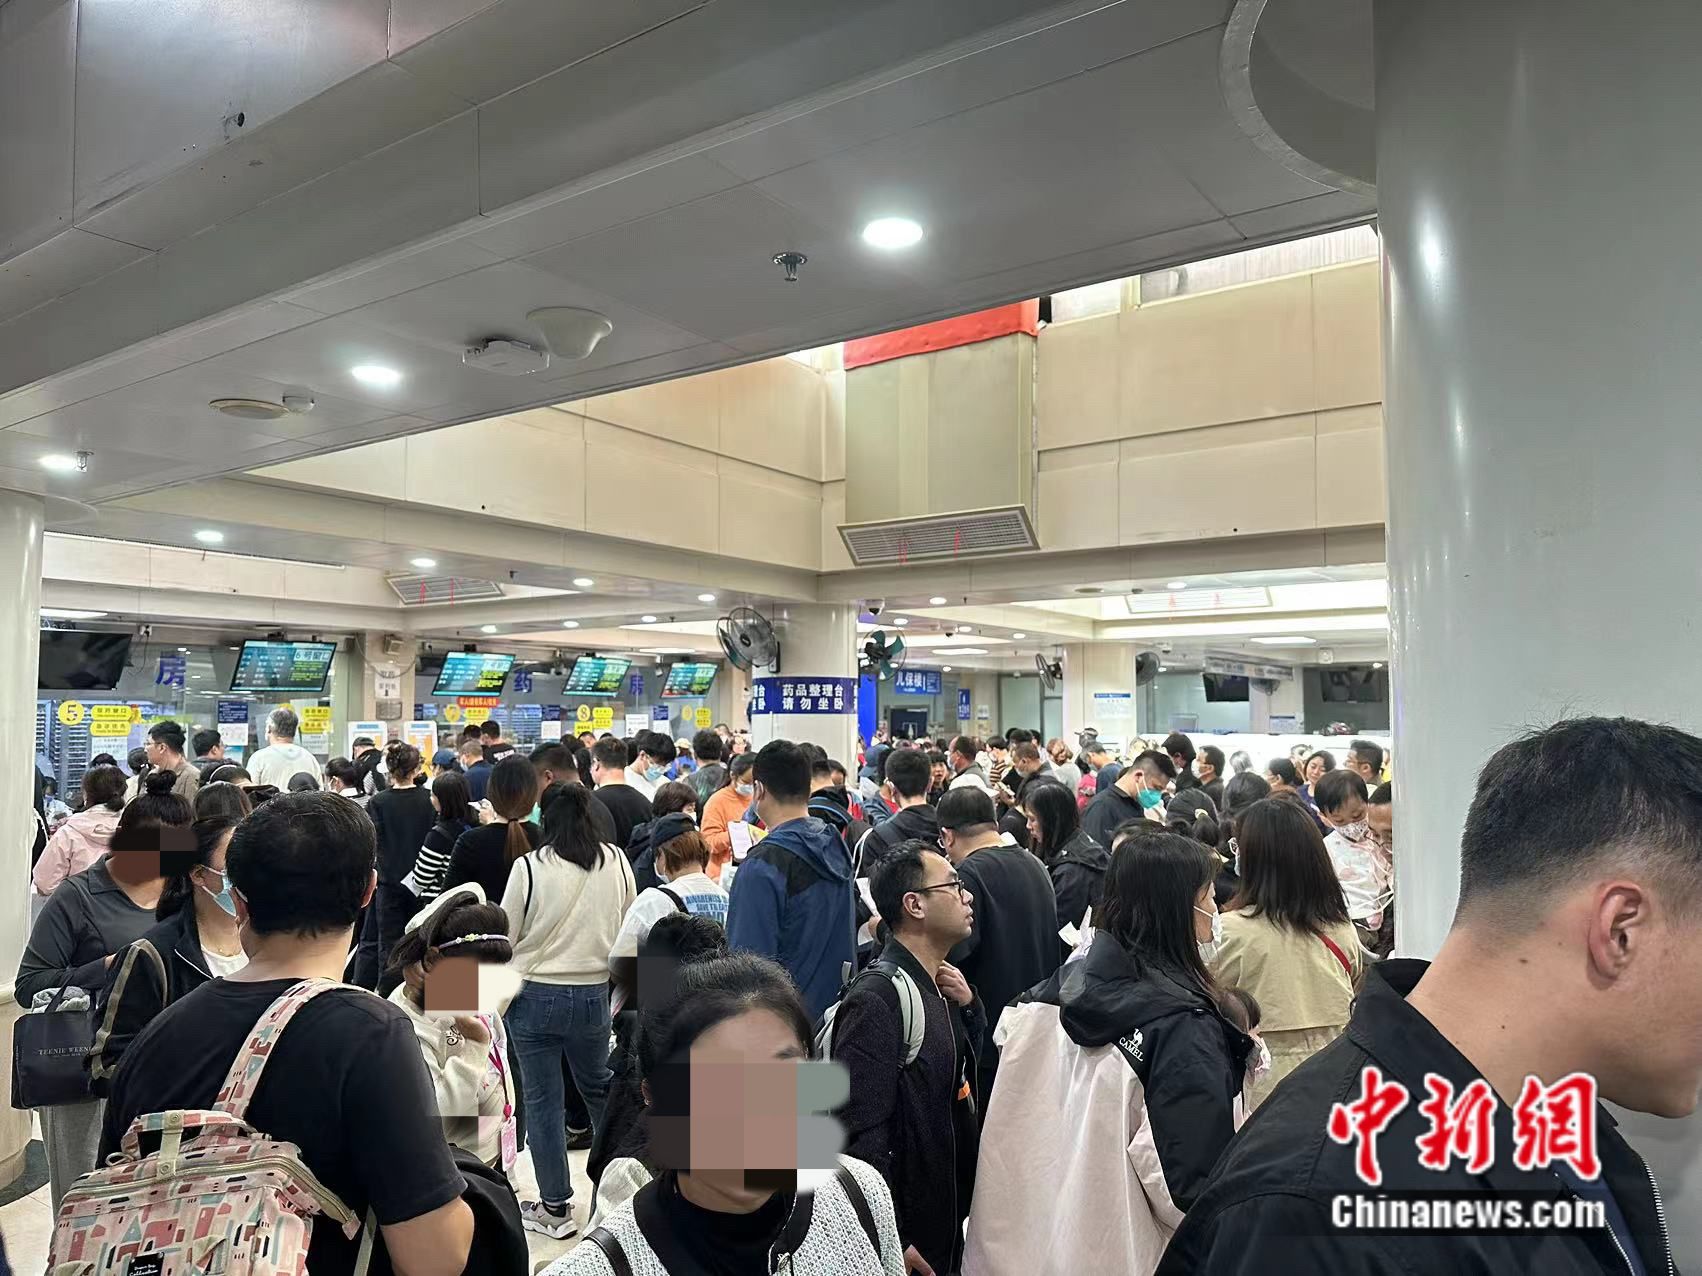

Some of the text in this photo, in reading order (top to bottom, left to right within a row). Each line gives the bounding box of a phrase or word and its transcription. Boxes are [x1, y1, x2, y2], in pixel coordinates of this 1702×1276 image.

[782, 683, 844, 697] 药品整理台
[782, 697, 844, 710] 请勿坐卧
[66, 704, 78, 722] 5
[580, 707, 588, 719] 8
[38, 1048, 66, 1056] TEENIE
[1119, 1036, 1144, 1062] CAMEL
